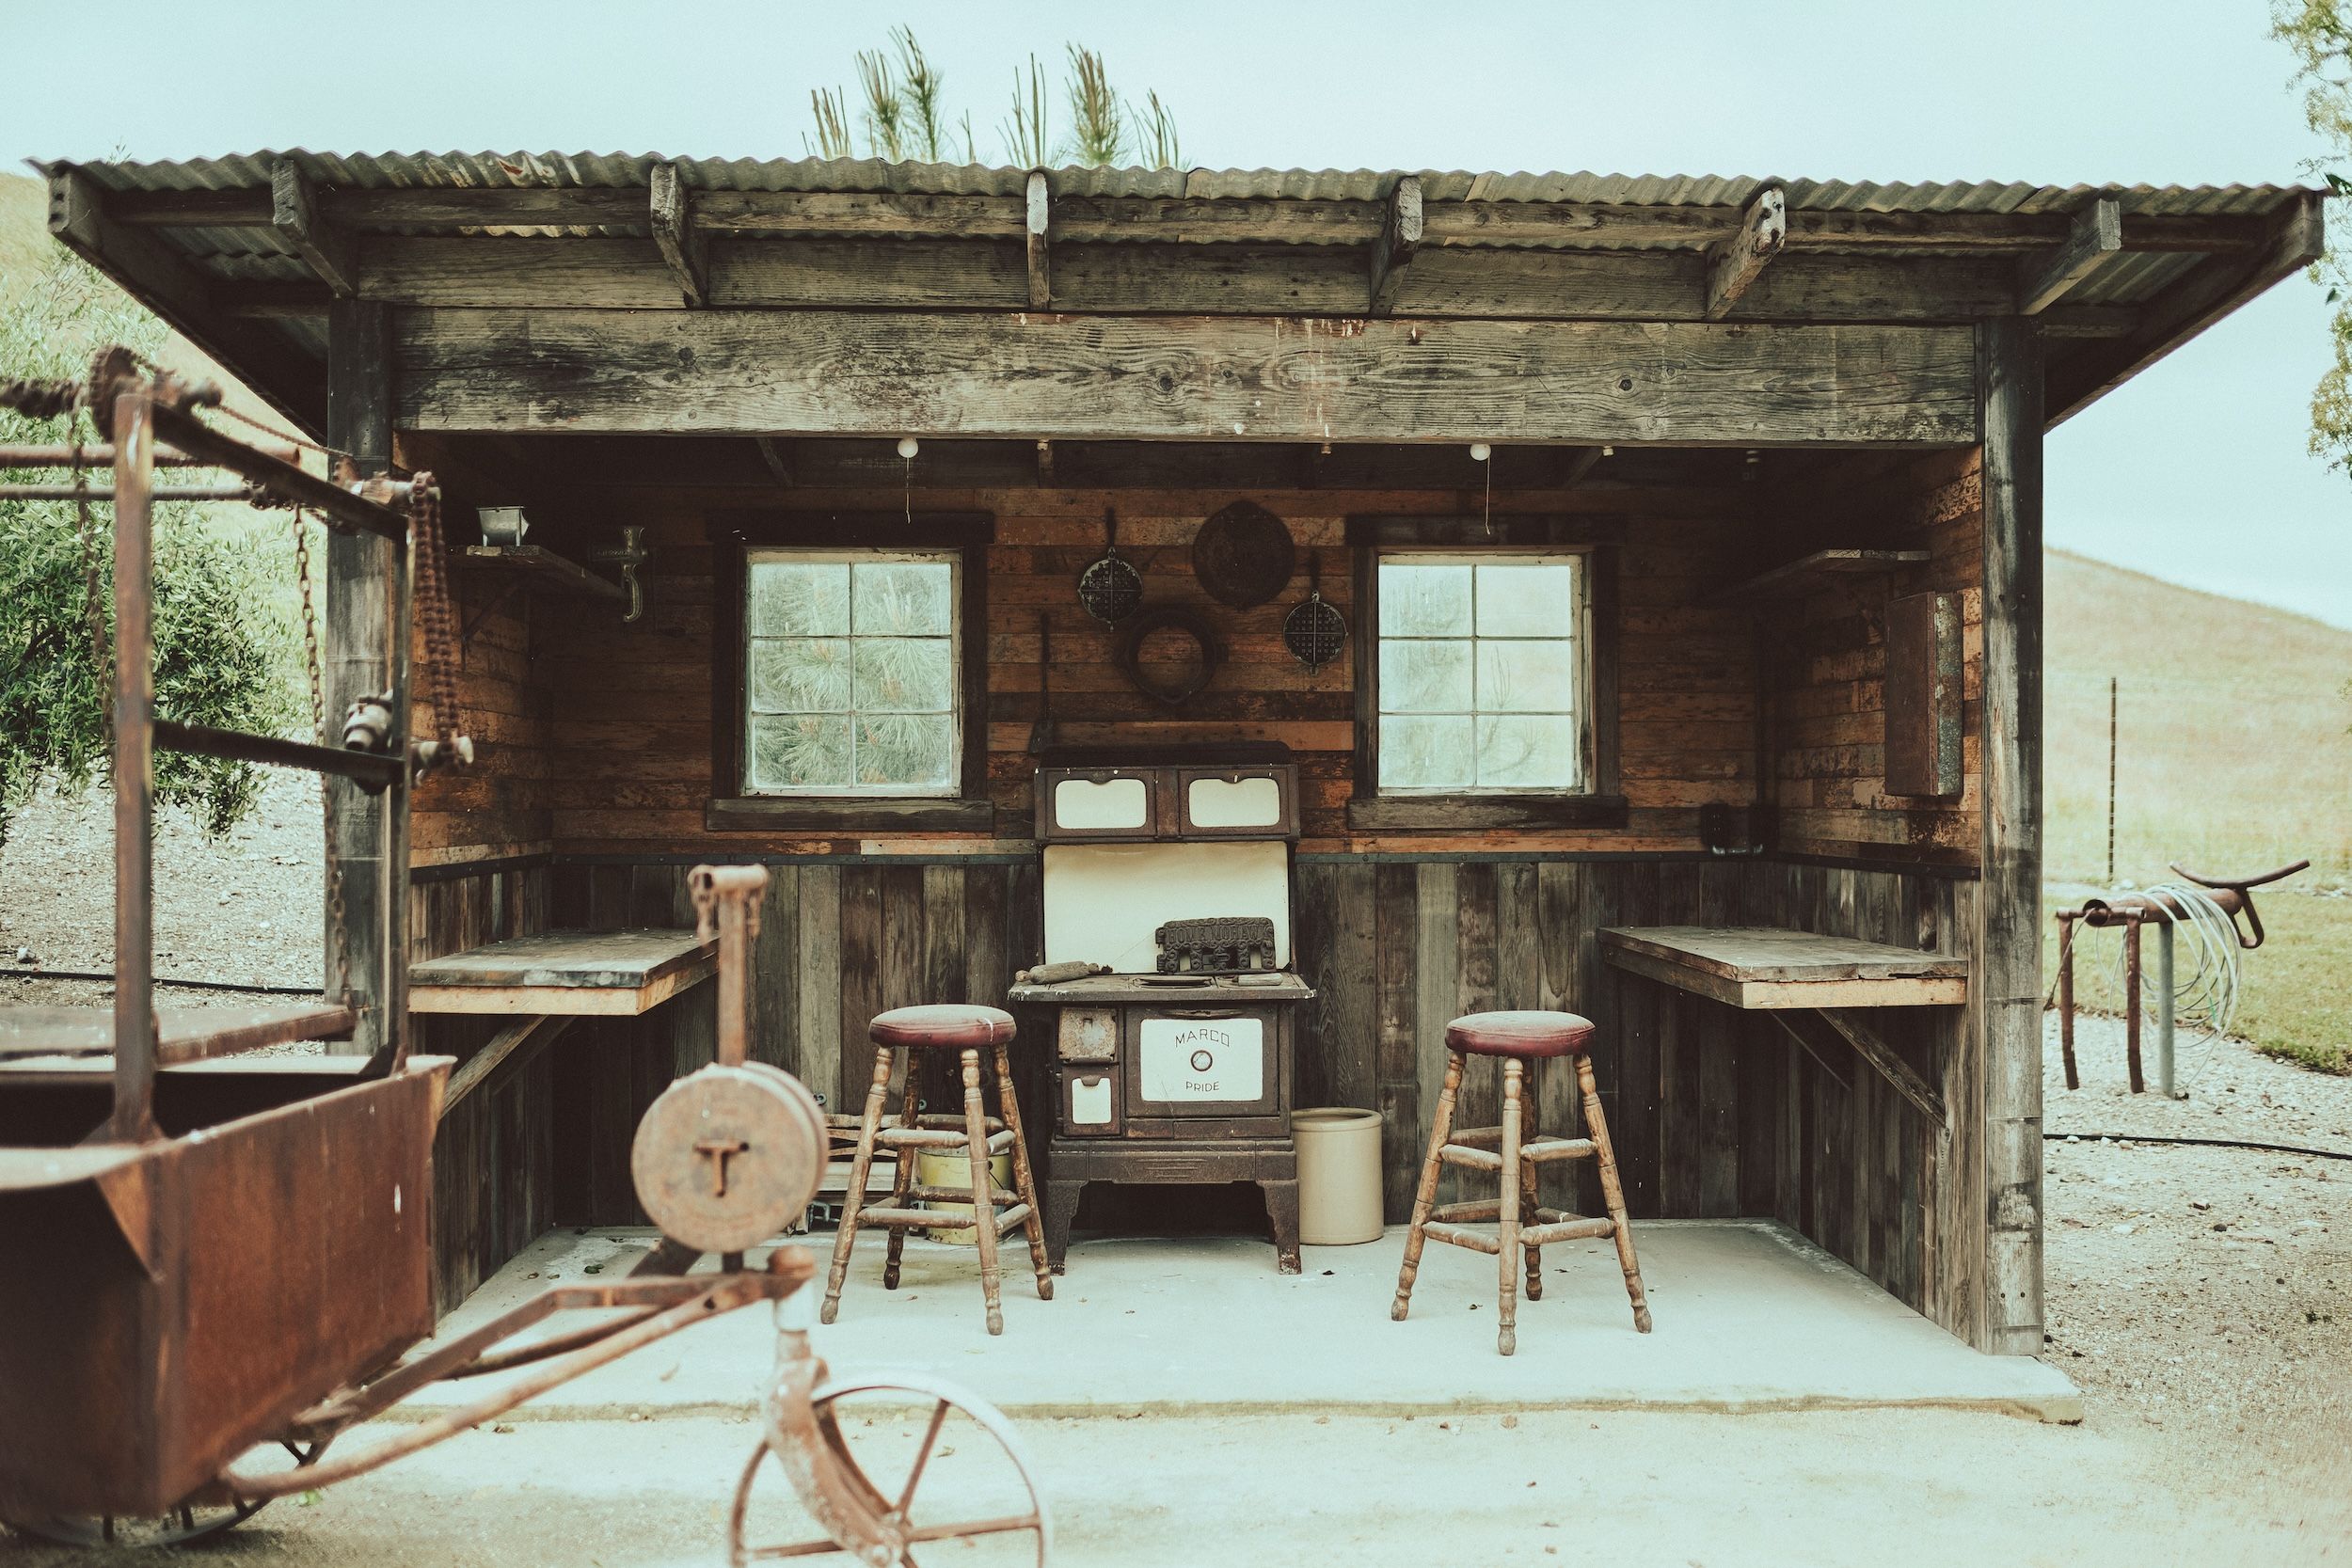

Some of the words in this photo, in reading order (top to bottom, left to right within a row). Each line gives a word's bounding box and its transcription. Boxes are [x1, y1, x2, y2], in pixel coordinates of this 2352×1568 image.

[1166, 927, 1205, 943] HOME
[1175, 1028, 1230, 1047] MARCO
[1185, 1081, 1220, 1092] PRIDE
